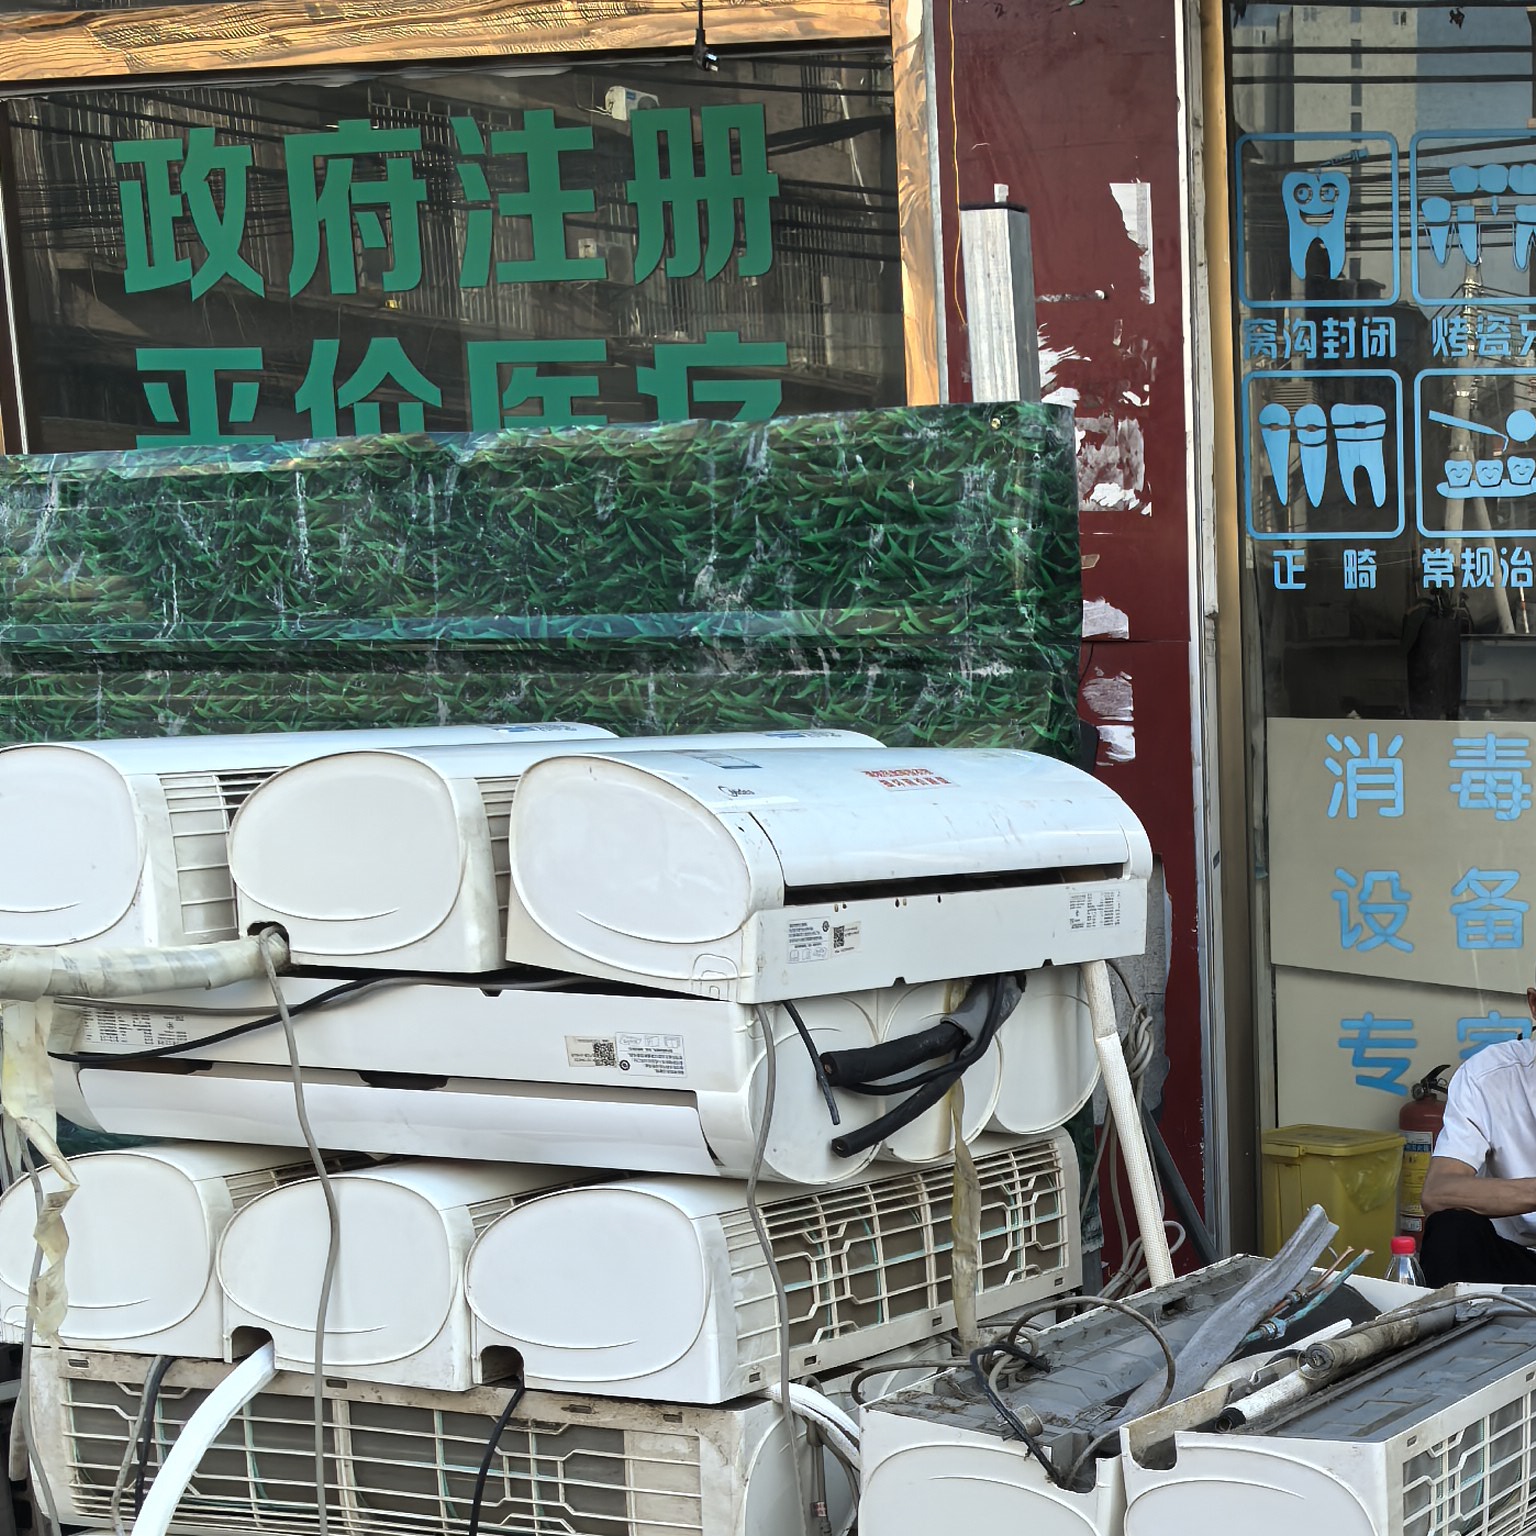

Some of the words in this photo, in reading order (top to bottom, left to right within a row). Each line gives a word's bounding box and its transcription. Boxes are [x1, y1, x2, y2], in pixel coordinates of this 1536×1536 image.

[114, 104, 779, 301] 政府注册
[1243, 316, 1397, 360] 窝沟封闭
